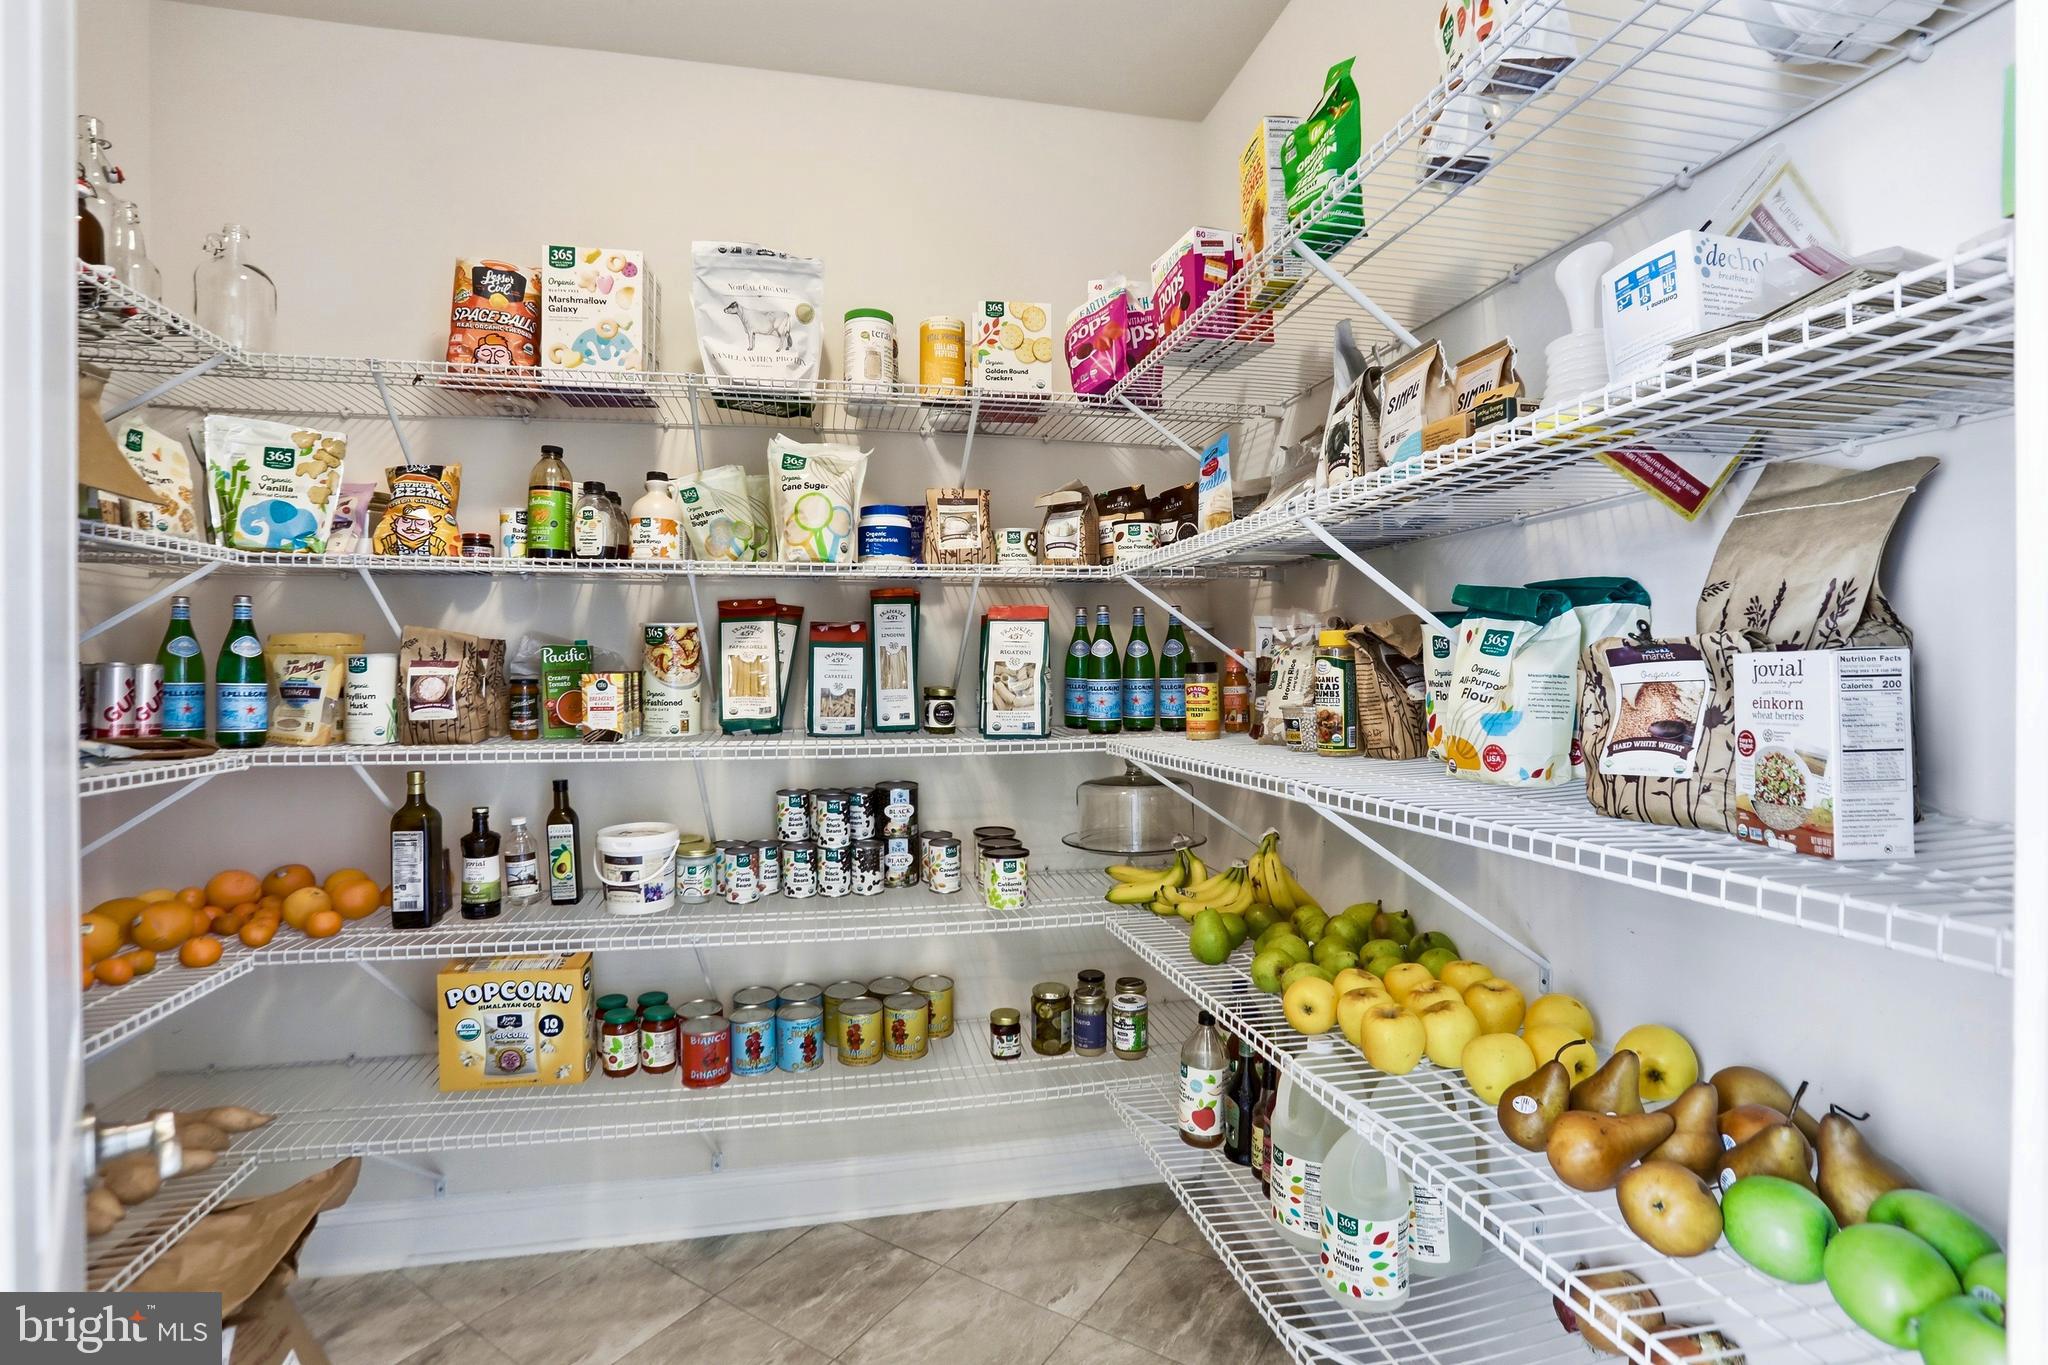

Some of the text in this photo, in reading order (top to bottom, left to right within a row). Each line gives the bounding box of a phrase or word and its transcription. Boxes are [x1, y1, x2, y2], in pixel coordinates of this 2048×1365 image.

[551, 248, 573, 262] 365
[481, 269, 515, 286] Lesser
[548, 277, 576, 288] Organic
[1158, 269, 1185, 320] pops
[548, 295, 607, 306] Marshmallow
[548, 304, 578, 315] Galaxy
[986, 304, 1002, 313] 365
[1079, 296, 1108, 318] EARTH
[453, 307, 538, 333] SPACE BALLS
[474, 323, 504, 332] ORGANIC
[1067, 313, 1111, 348] pops
[1126, 323, 1156, 349] ops
[985, 374, 1013, 382] Crackers
[266, 450, 292, 463] 365
[784, 456, 804, 467] 365
[261, 475, 292, 484] Organic
[781, 475, 802, 483] Organic
[258, 483, 293, 493] Vanilla
[782, 482, 829, 492] Cane Sugar
[683, 490, 697, 499] 365
[689, 508, 724, 521] Light Brown
[691, 519, 709, 528] Sugar
[646, 628, 662, 639] 365
[999, 625, 1035, 638] FRANKIES
[1008, 632, 1023, 641] 457
[1433, 638, 1449, 650] 365
[1484, 633, 1509, 647] 365
[542, 647, 586, 663] Pacific
[824, 651, 853, 661] FRANKIES
[1641, 653, 1677, 661] market
[1839, 655, 1876, 663] Nutrition
[349, 658, 366, 668] 365
[1471, 663, 1501, 678] Organic
[1640, 669, 1681, 681] Organic
[1752, 658, 1803, 684] jovial
[547, 674, 570, 682] Creamy
[1282, 658, 1297, 701] Brown Rice
[1428, 680, 1443, 688] Whole
[1840, 680, 1902, 690] Calories 200
[1435, 690, 1449, 701] Flo
[1461, 688, 1494, 704] Flour
[350, 701, 369, 710] Husk
[1752, 696, 1804, 710] einkorn
[1752, 711, 1805, 721] wheat berries
[1613, 740, 1685, 752] HARD WHITE WHEAT
[1487, 753, 1501, 763] USA
[466, 860, 486, 869] jovial
[445, 980, 573, 1009] POPCORN
[478, 1002, 521, 1011] HIMALAYAN
[543, 1018, 559, 1029] 10
[735, 1023, 771, 1034] BIANCO
[490, 1032, 530, 1041] POPCORN
[690, 1032, 727, 1045] BIANCO
[1339, 1217, 1357, 1231] 365
[1337, 1235, 1357, 1247] Organic
[1335, 1248, 1360, 1263] White
[1332, 1253, 1364, 1272] Vinegar
